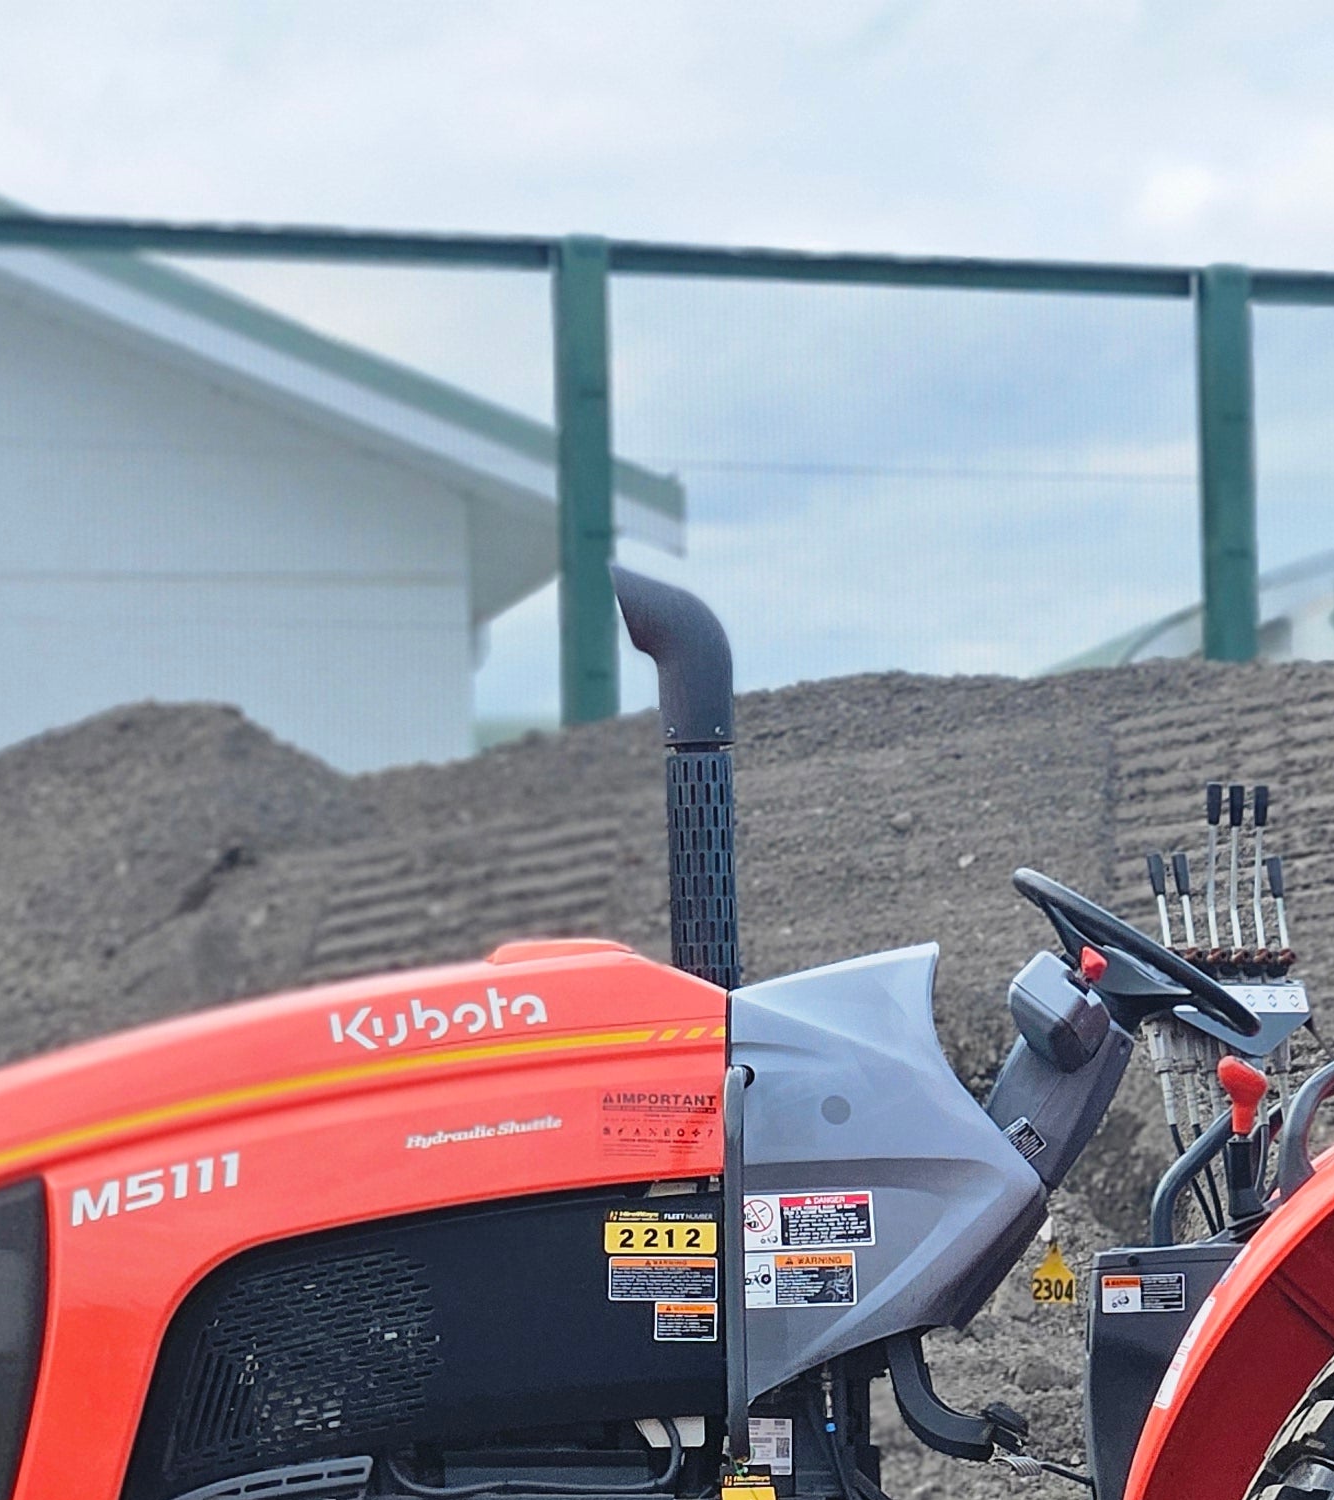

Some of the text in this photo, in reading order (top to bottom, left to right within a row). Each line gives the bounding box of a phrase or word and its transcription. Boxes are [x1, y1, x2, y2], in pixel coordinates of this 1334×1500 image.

[329, 987, 548, 1050] Kubota
[616, 1093, 716, 1106] IMPORTANT
[405, 1114, 562, 1149] Hydraulic Shuttle
[71, 1151, 240, 1227] M5111
[813, 1195, 845, 1204] DANGER
[619, 1228, 701, 1248] 2212
[1033, 1278, 1074, 1300] 2304
